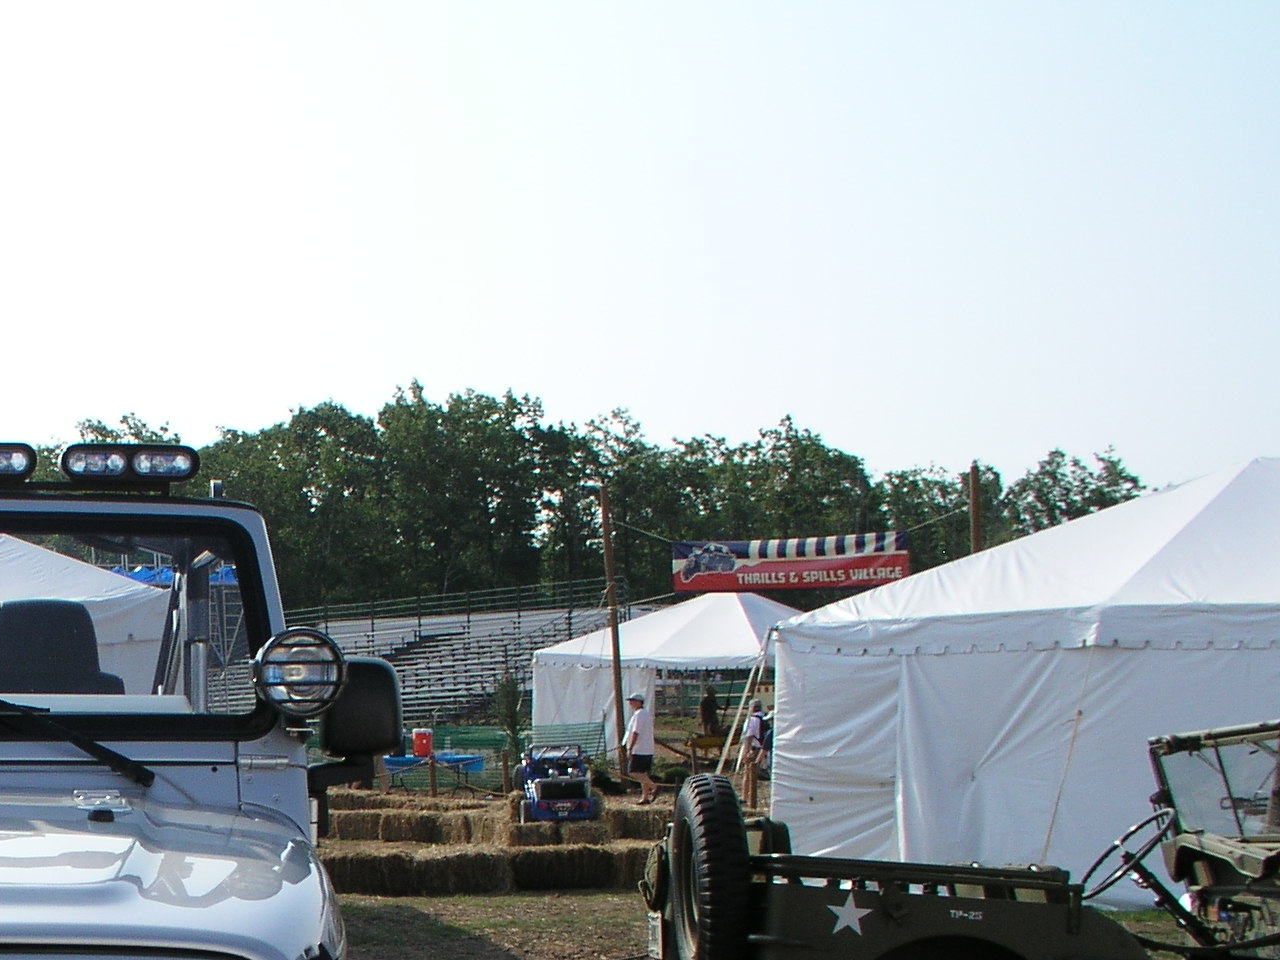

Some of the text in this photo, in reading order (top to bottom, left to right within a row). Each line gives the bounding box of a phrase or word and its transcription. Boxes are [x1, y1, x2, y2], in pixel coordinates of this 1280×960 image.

[737, 566, 903, 585] THRILLS & SPILLS VILLAGE
